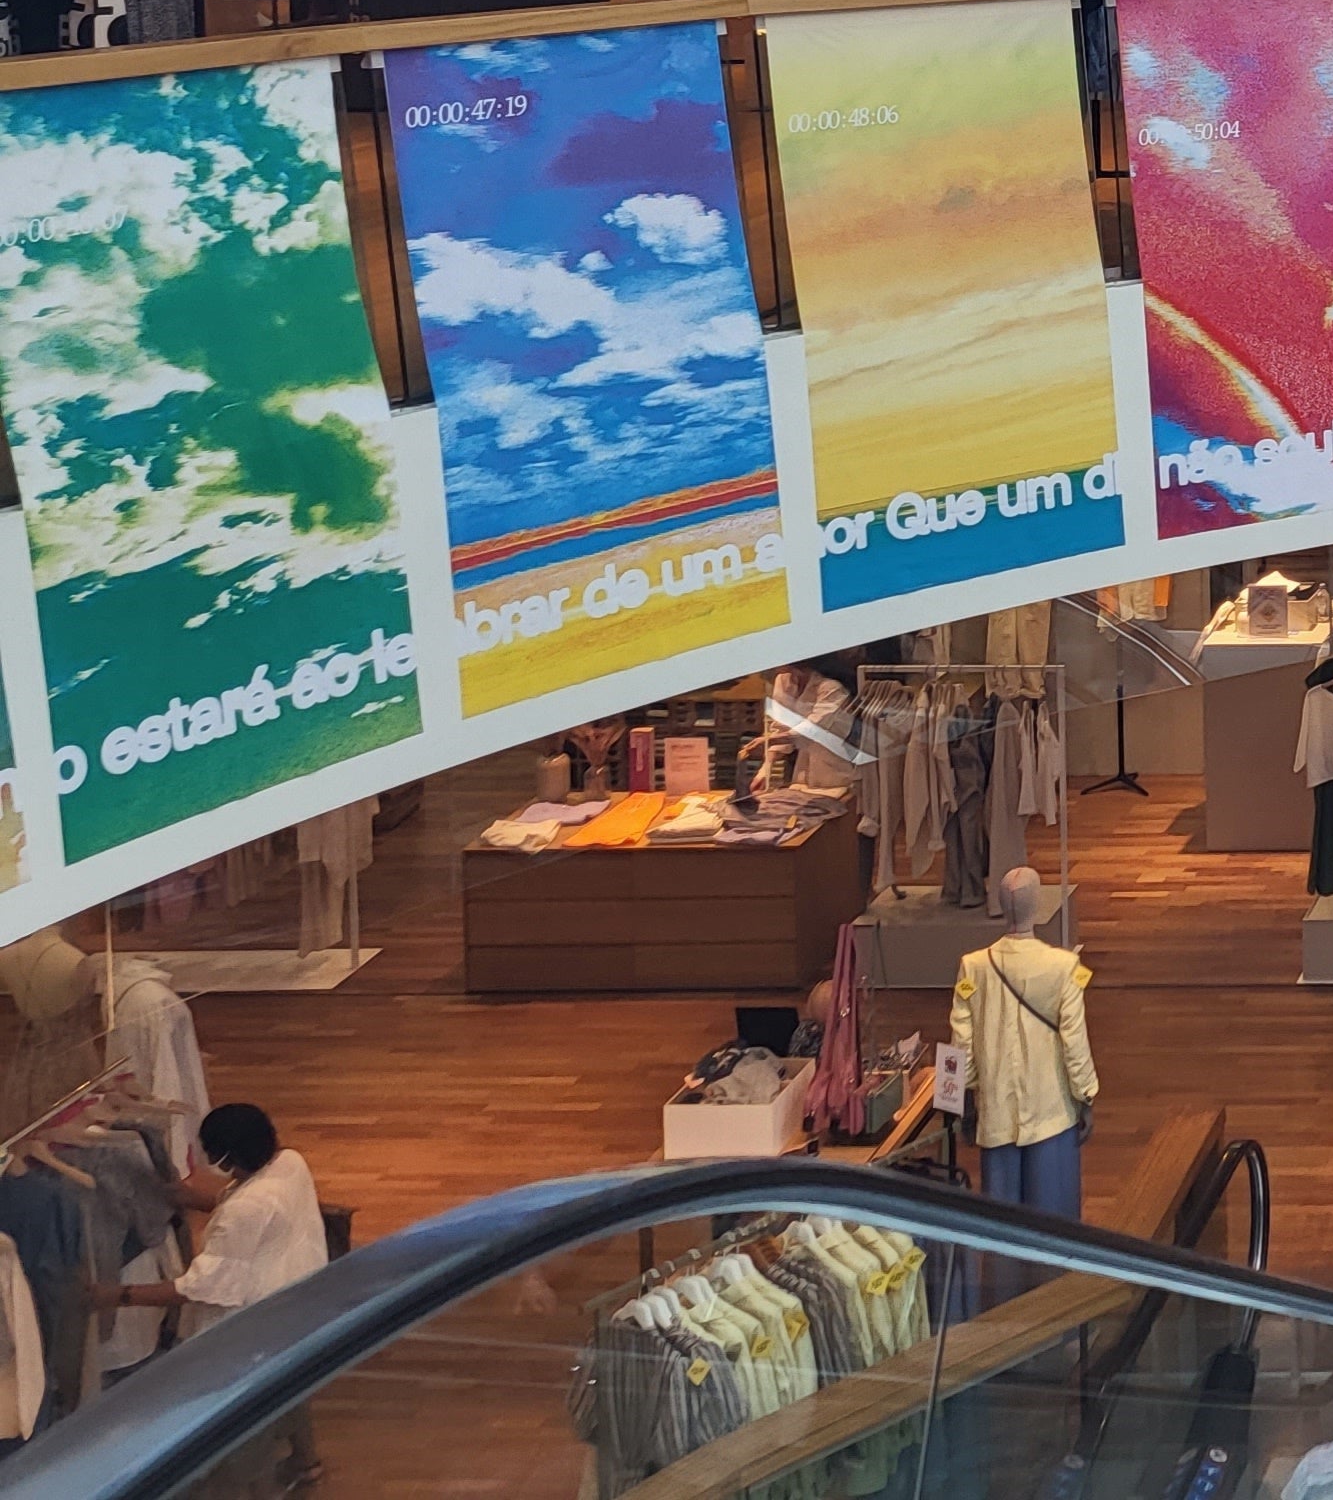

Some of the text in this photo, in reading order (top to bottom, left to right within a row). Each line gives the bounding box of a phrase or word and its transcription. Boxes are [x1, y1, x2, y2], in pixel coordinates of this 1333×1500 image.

[405, 95, 528, 129] 00:00:47:19
[788, 105, 899, 134] 00:00:48:06
[885, 489, 987, 540] Que
[997, 471, 1074, 519] um
[582, 563, 651, 619] de
[661, 543, 744, 597] um
[101, 664, 282, 776] estará
[291, 651, 361, 711] ao
